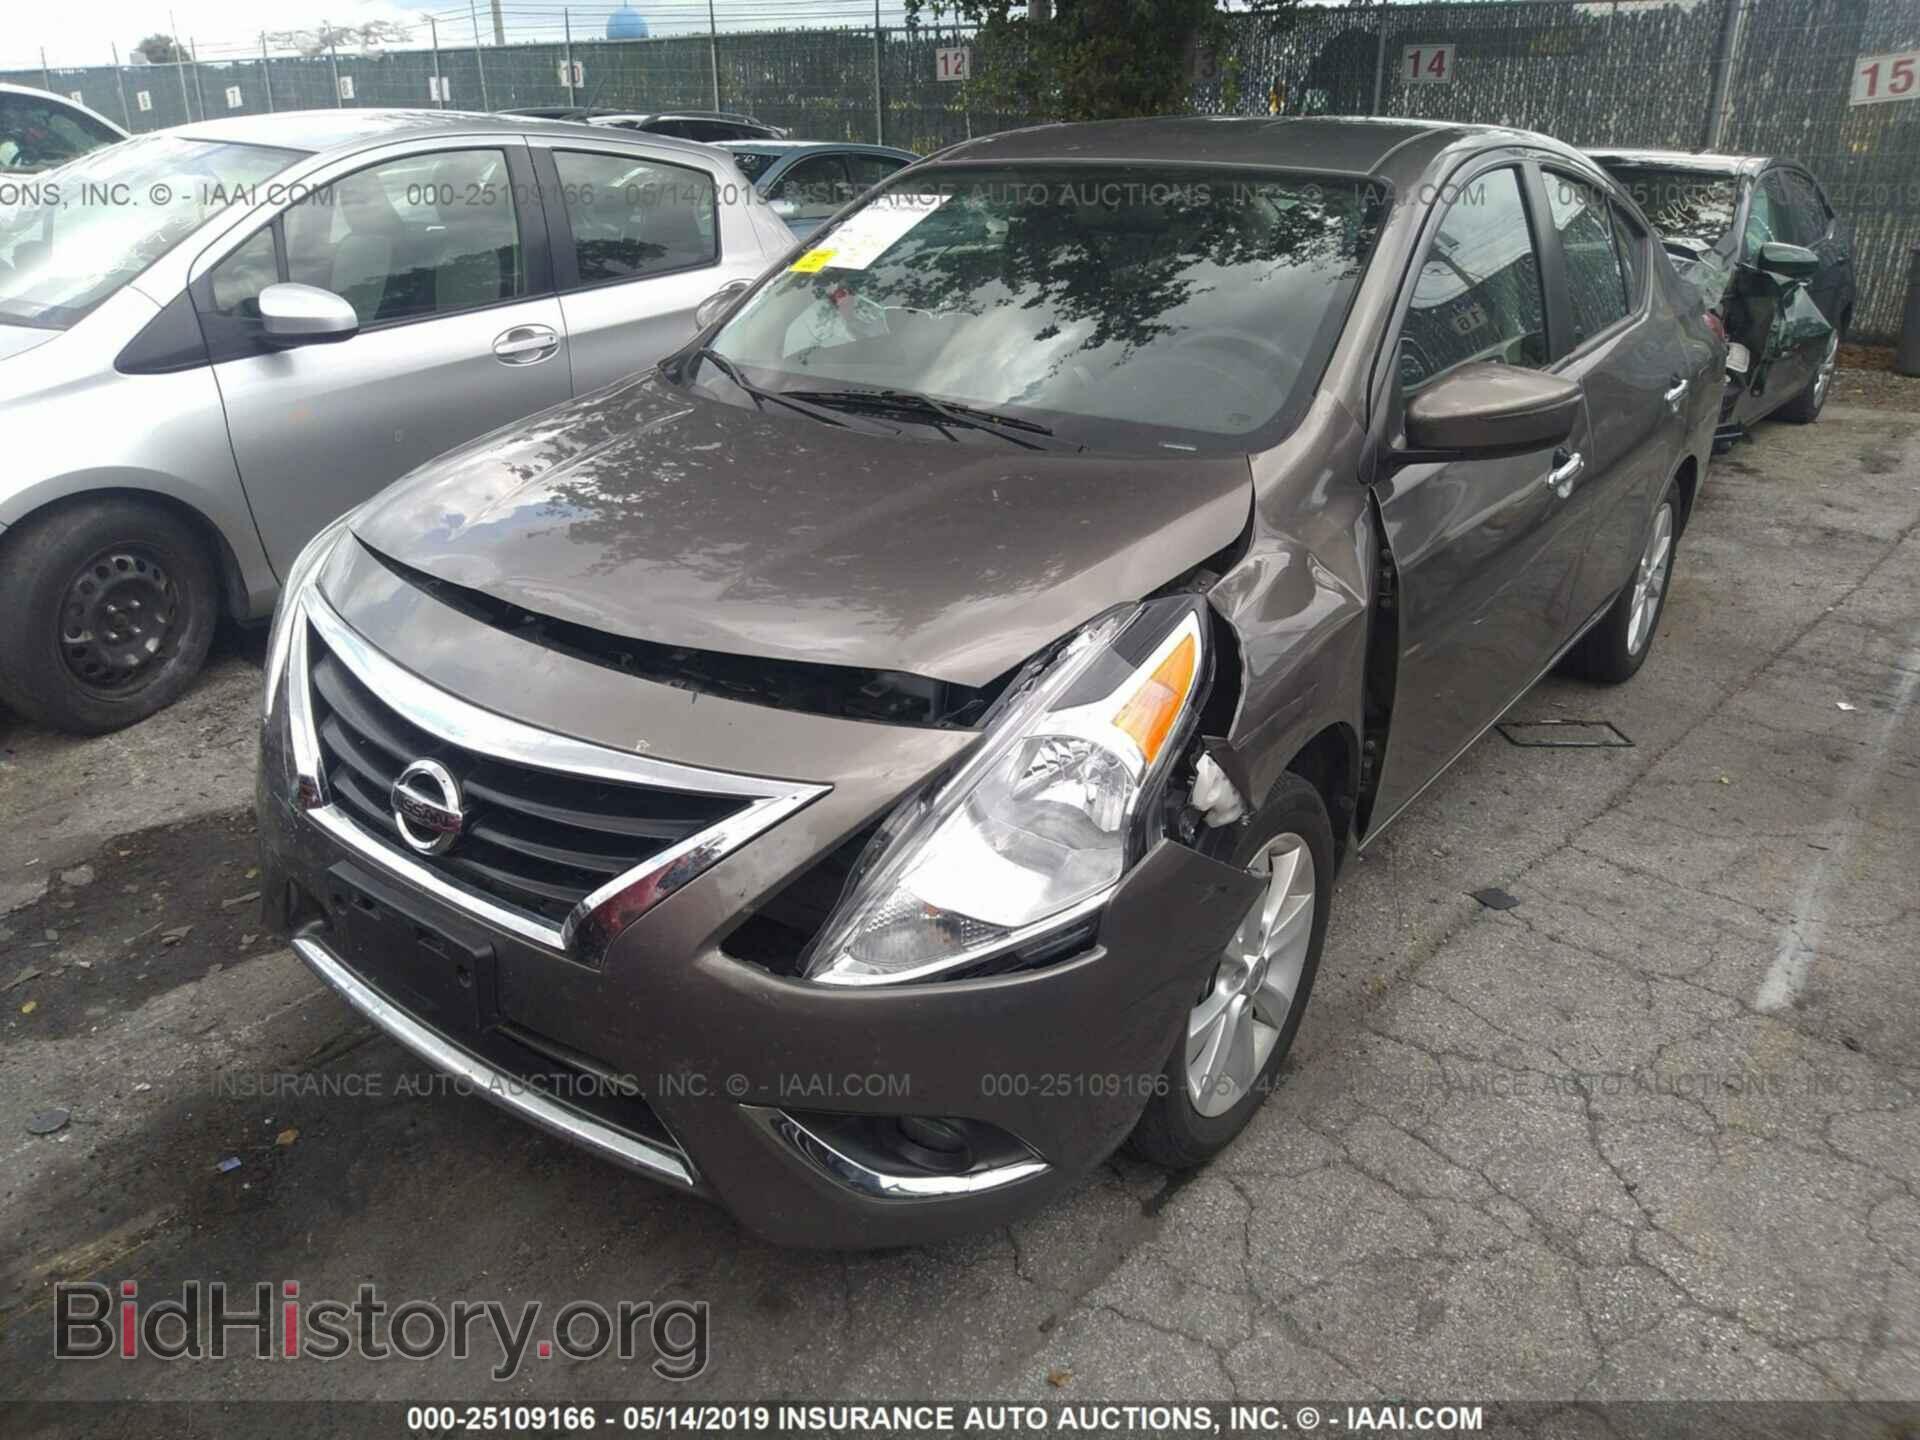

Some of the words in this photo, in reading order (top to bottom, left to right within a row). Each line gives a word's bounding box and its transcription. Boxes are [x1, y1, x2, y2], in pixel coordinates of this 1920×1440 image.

[939, 52, 966, 76] 12
[1408, 48, 1446, 78] 14
[1861, 57, 1915, 97] 15
[228, 89, 239, 105] 7
